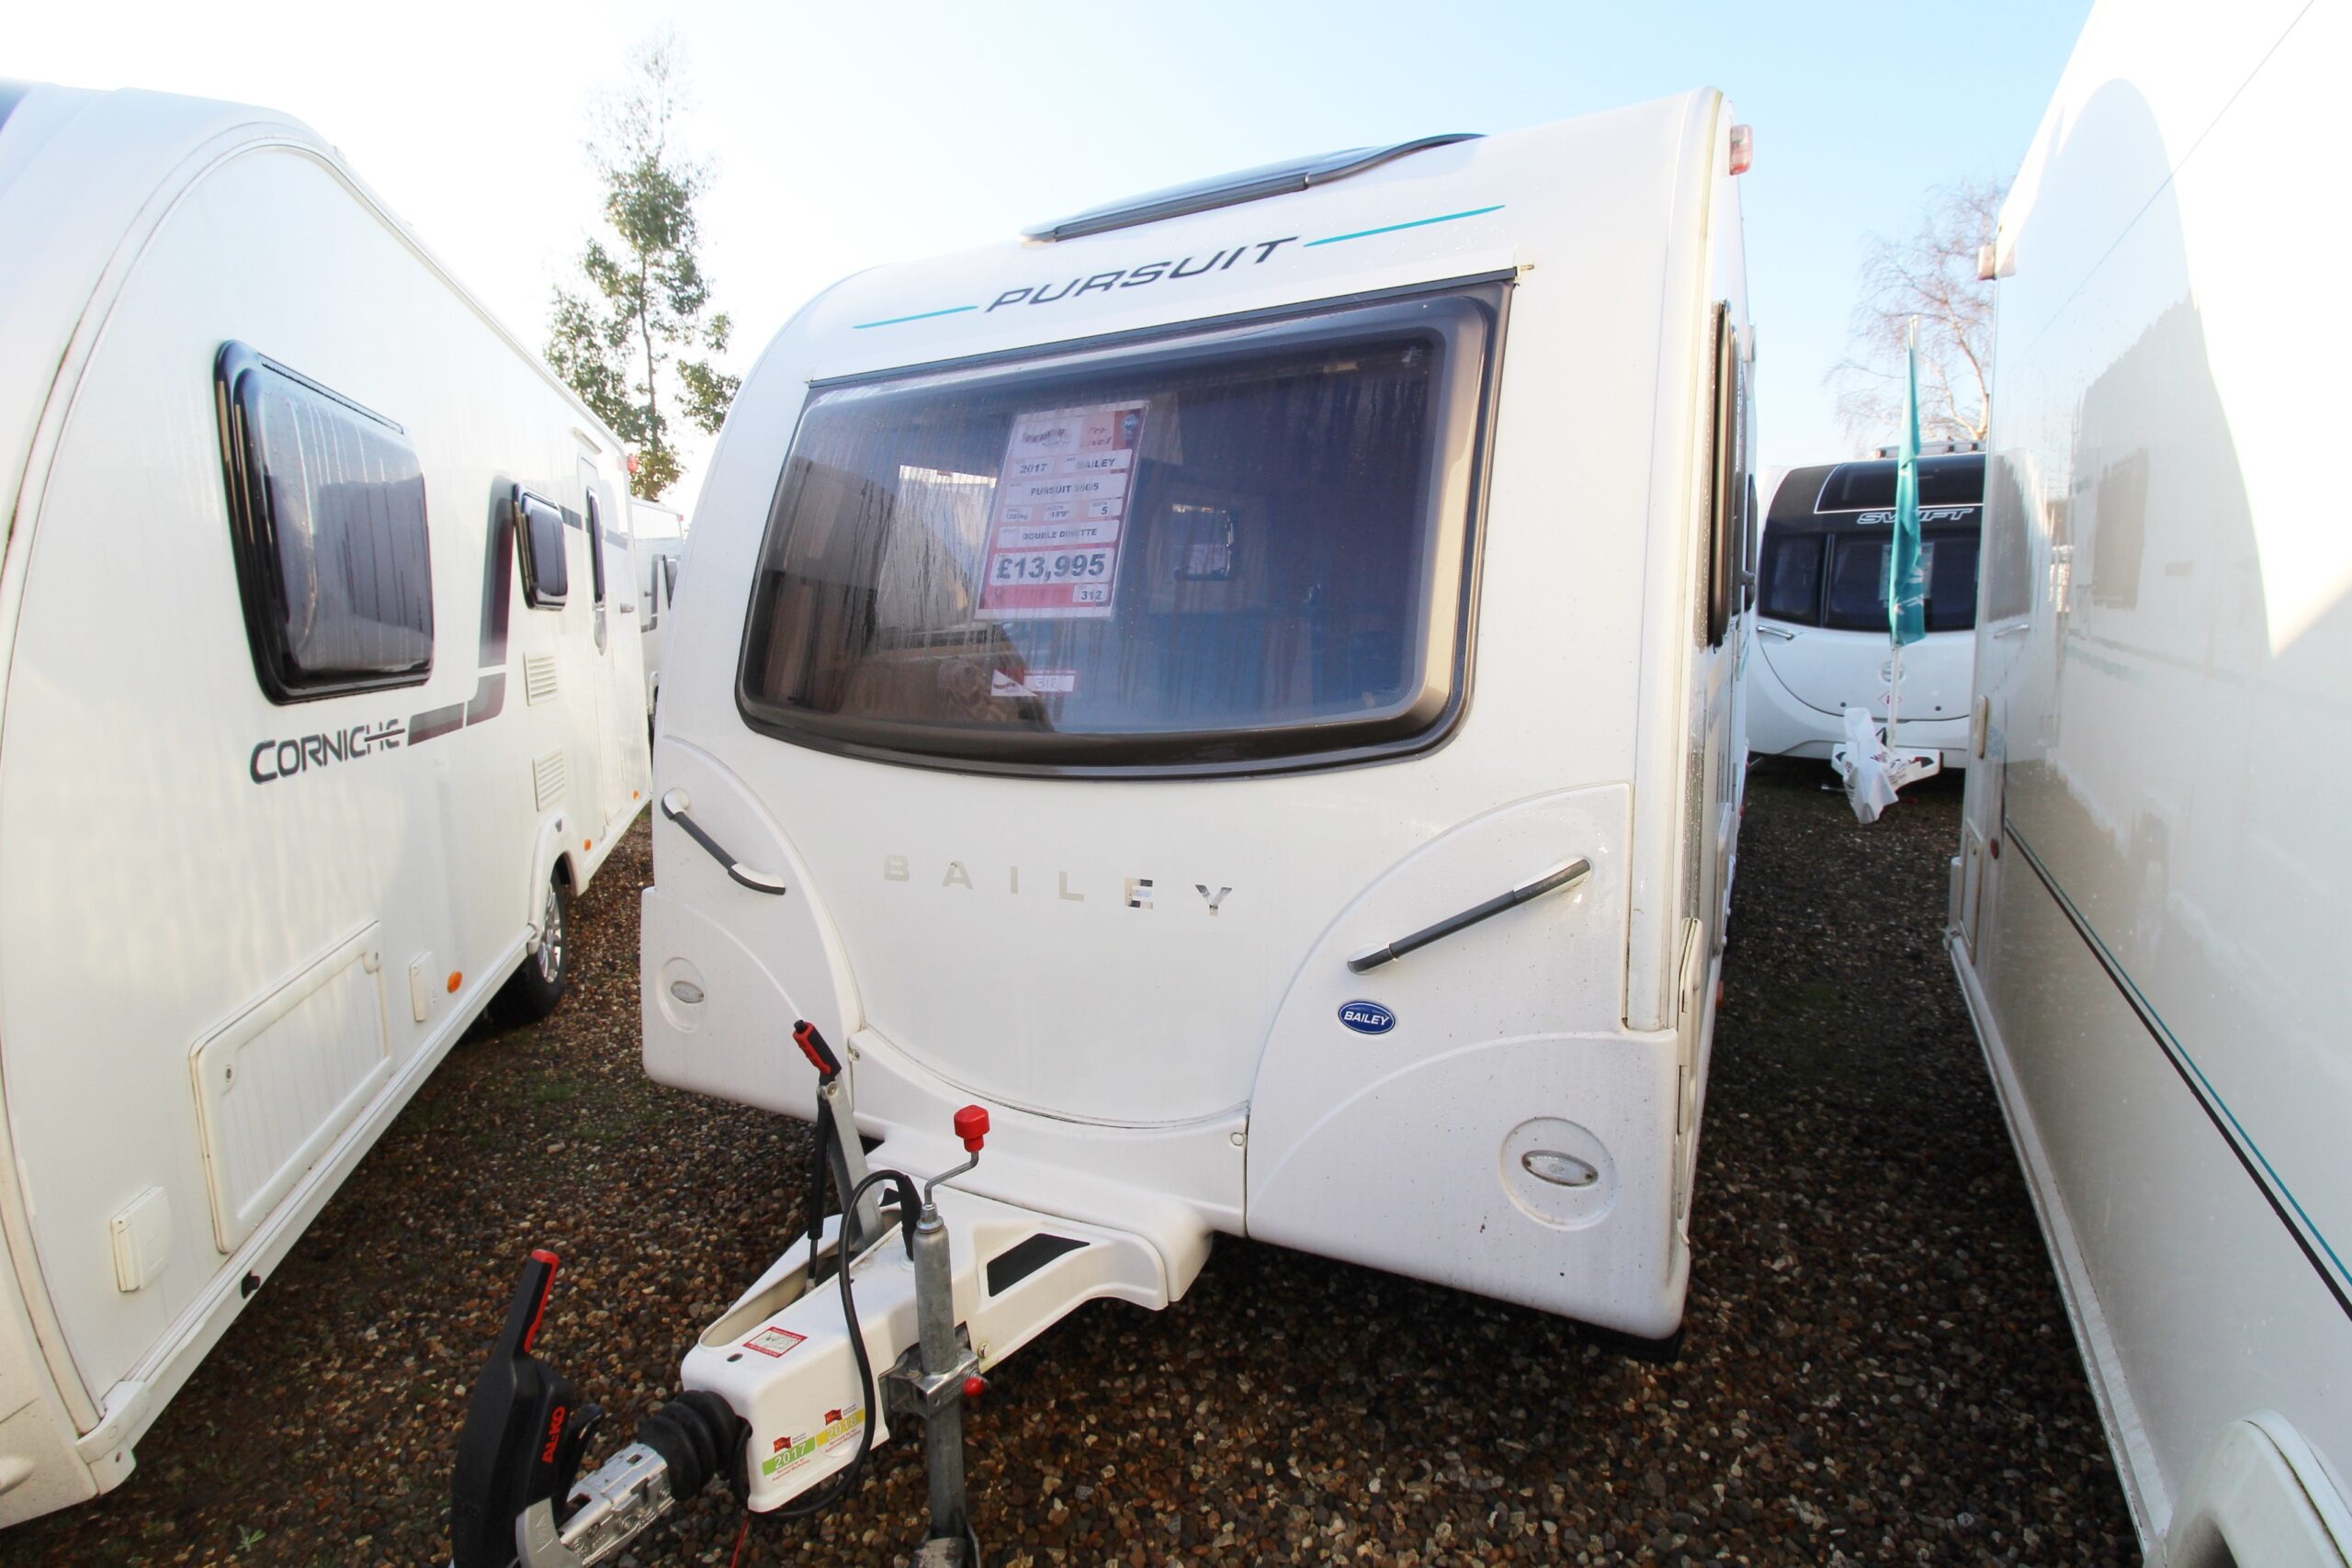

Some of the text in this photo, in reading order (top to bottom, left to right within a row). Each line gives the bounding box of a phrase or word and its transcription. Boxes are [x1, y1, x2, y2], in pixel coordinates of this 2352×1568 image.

[985, 236, 1299, 313] PURSUIT
[1020, 457, 1116, 474] 2017 BAILEY
[1030, 485, 1072, 496] PURSUIT
[1101, 506, 1108, 515] 5
[1023, 531, 1057, 540] DOUBLE
[996, 553, 1105, 581] £13,995
[1081, 591, 1102, 600] 312
[250, 719, 405, 784] CORNICHE
[884, 854, 1233, 917] BAILEY
[1344, 1010, 1389, 1025] BAILEY
[829, 1415, 856, 1440] 2018
[775, 1442, 806, 1469] 2017
